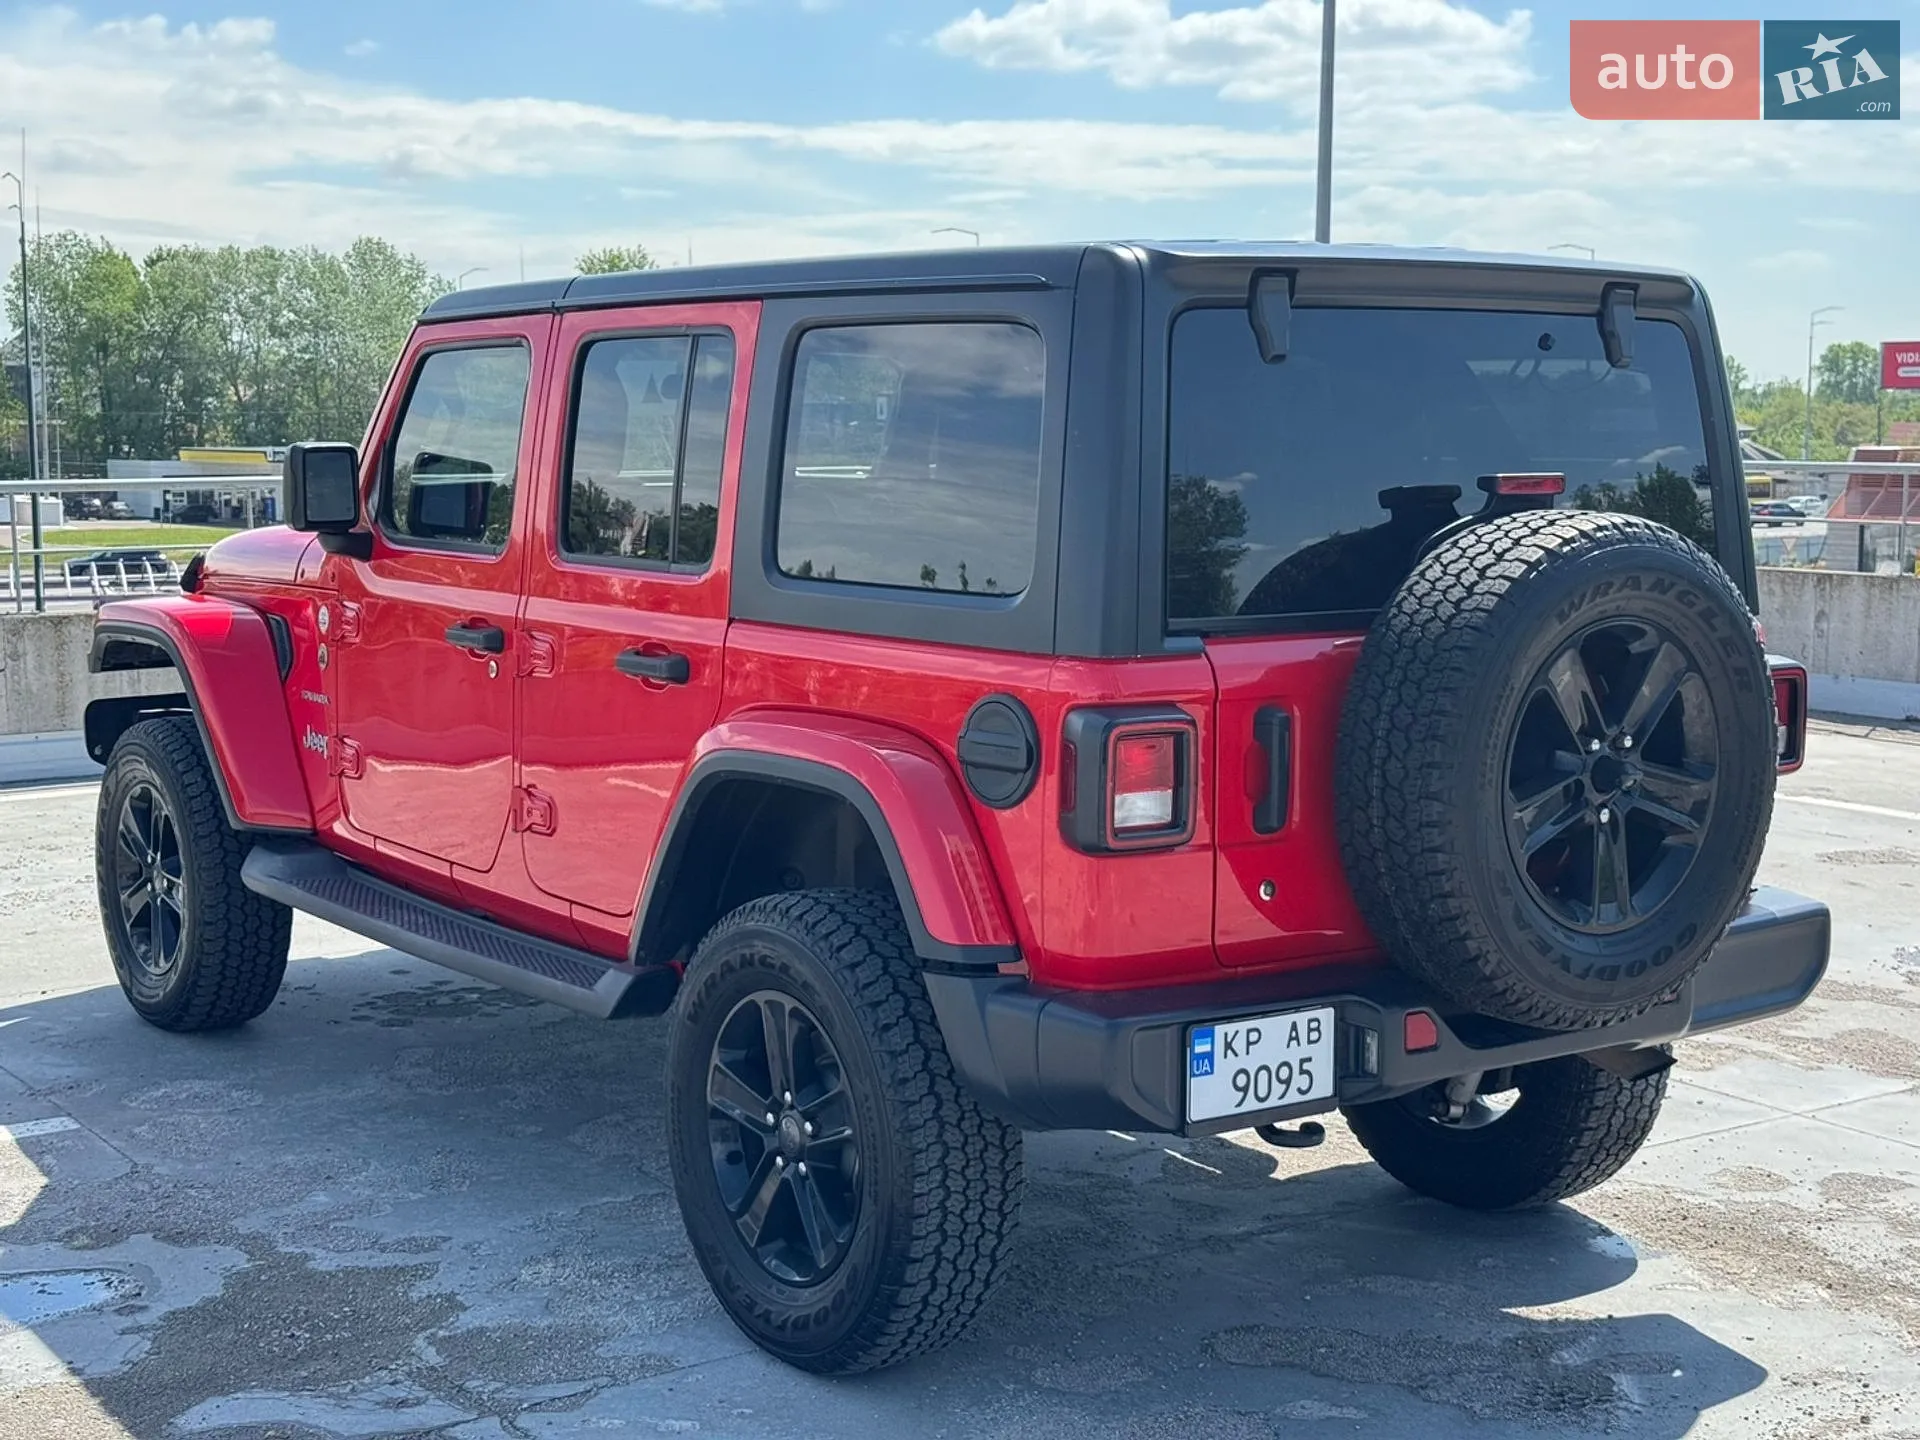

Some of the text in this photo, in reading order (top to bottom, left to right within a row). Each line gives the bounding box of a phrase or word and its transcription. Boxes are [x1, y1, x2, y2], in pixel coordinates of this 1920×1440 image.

[1555, 574, 1754, 694] WRANGLER
[1223, 1017, 1322, 1059] KP AB
[1193, 1059, 1212, 1075] UA
[1231, 1056, 1313, 1108] 9095
